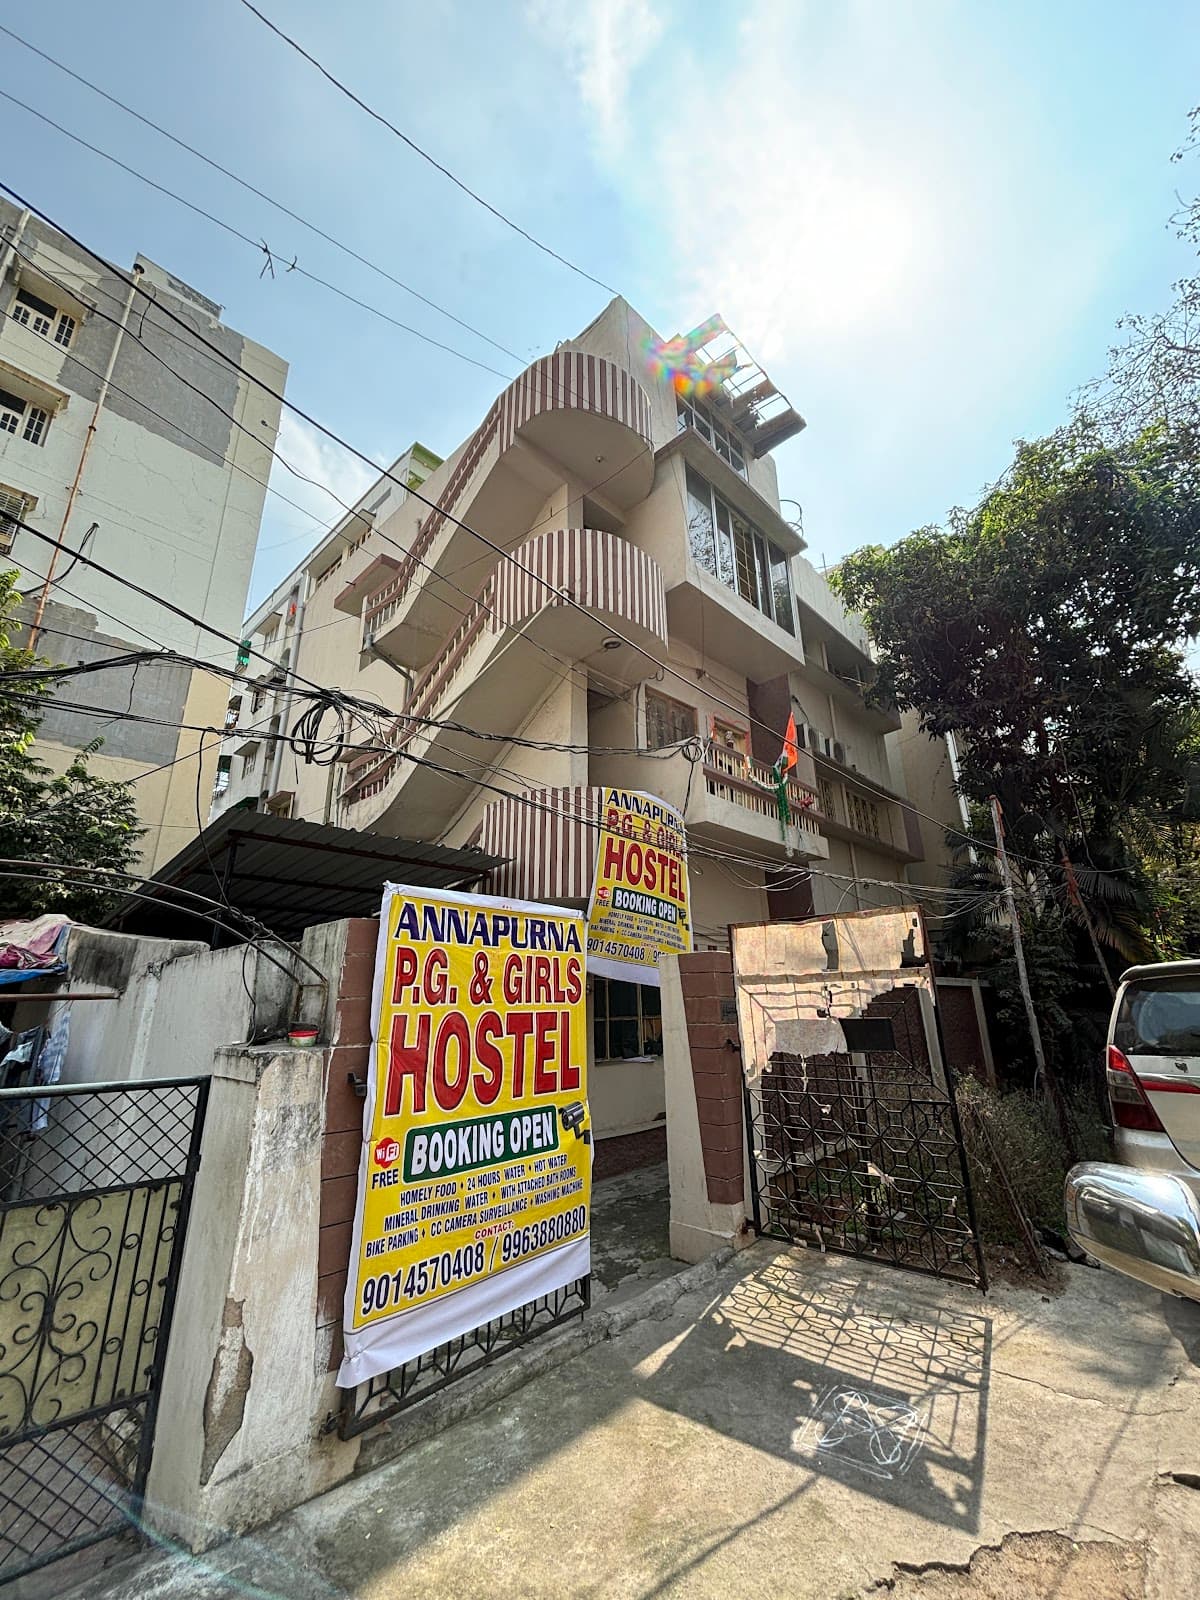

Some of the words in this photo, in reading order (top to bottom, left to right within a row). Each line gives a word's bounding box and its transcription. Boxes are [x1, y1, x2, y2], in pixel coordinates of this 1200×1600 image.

[604, 837, 685, 902] HOSTEL
[394, 902, 582, 952] ANNAPURNA
[615, 890, 657, 915] BOOKING
[658, 902, 676, 922] OPEN
[392, 947, 457, 1005] P.G.
[470, 952, 493, 1005] &
[503, 953, 582, 1005] GIRLS
[587, 938, 645, 961] 9014570408
[384, 1011, 580, 1116] HOSTEL
[410, 1120, 504, 1176] BOOKING
[510, 1111, 554, 1152] OPEN
[372, 1169, 399, 1189] FREE
[384, 1209, 418, 1232] MINERAL
[421, 1199, 460, 1220] DRINKING
[465, 1192, 488, 1210] WATER
[501, 1185, 516, 1199] WITH
[517, 1176, 545, 1195] ATTACHED
[546, 1172, 558, 1186] BATH
[560, 1167, 576, 1181] ROOMS
[400, 1186, 433, 1206] HOMELY
[435, 1182, 457, 1198] FOOD
[467, 1177, 475, 1191] 24
[477, 1171, 501, 1187] HOURS
[504, 1165, 525, 1180] WATER
[534, 1159, 546, 1173] HOT
[548, 1154, 567, 1169] WATER
[366, 1239, 386, 1257] BIKE
[388, 1228, 419, 1251] PARKING
[431, 1221, 442, 1237] CC
[445, 1213, 477, 1232] CAMERA
[480, 1198, 528, 1223] SURVEILLANCE
[535, 1187, 560, 1205] WASHING
[562, 1179, 583, 1196] MACHINE
[475, 1220, 514, 1239] CONTACT:
[362, 1241, 484, 1315] 9014570408
[502, 1206, 586, 1263] 9963880880
